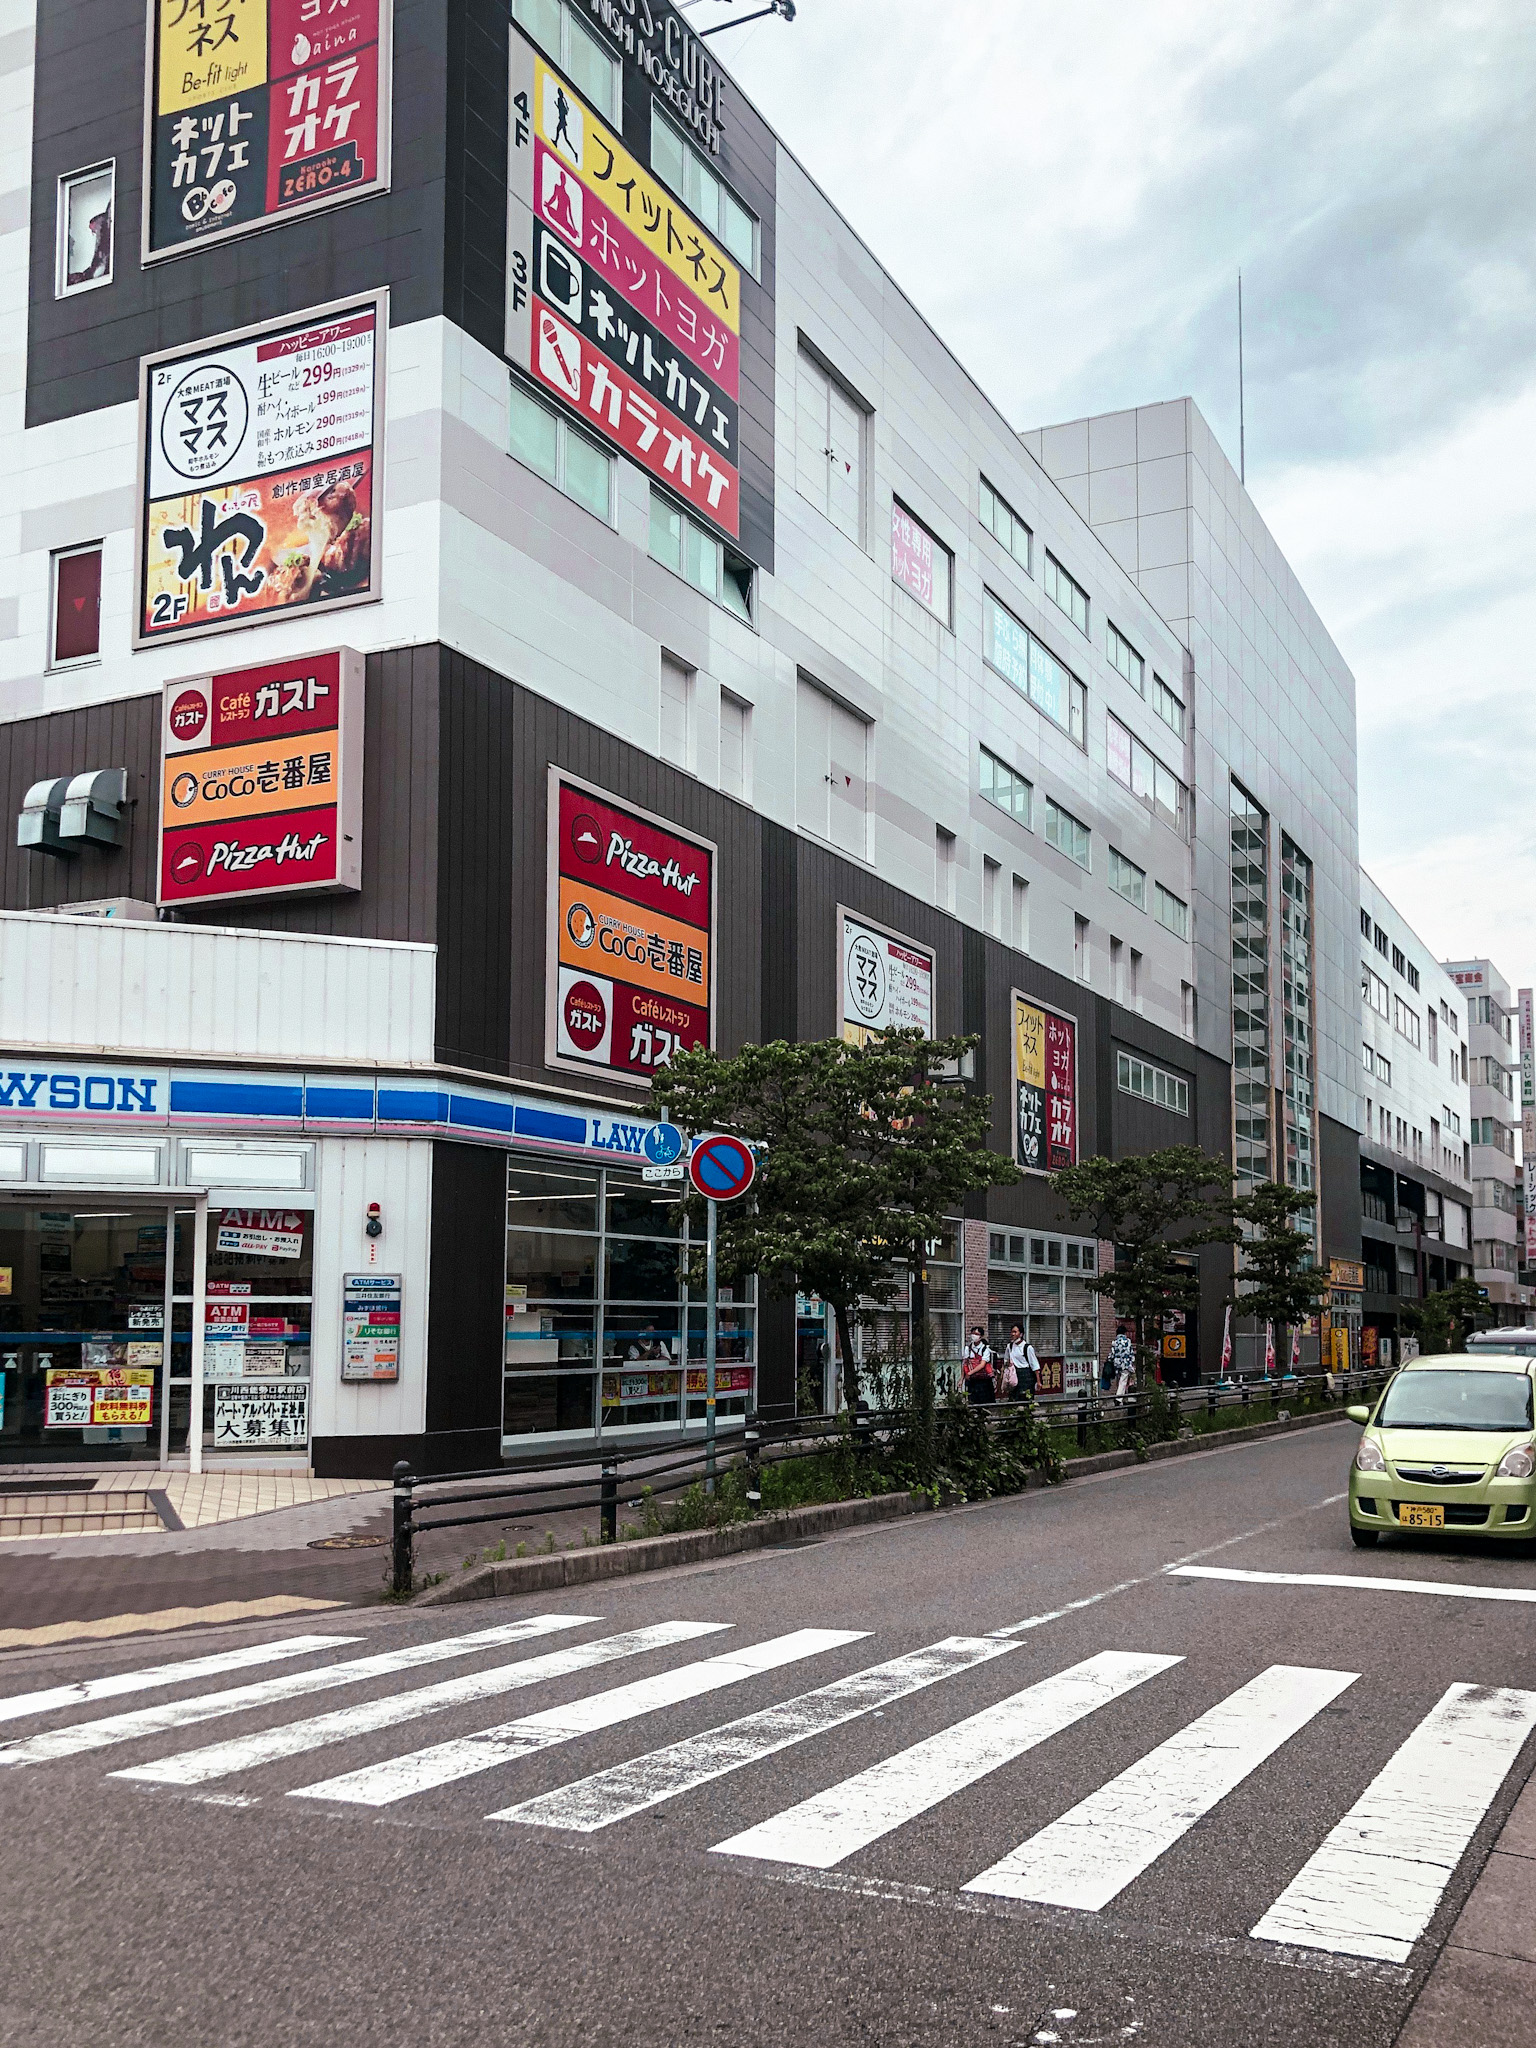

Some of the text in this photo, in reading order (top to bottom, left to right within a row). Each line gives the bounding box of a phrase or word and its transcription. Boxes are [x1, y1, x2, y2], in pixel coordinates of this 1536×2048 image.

[186, 14, 239, 57] ネス
[313, 28, 357, 55] aina
[182, 61, 248, 94] Be-fit light
[287, 56, 359, 118] カラ
[637, 39, 720, 155] NOSEGUCHI
[171, 102, 253, 152] ネット
[284, 101, 360, 159] オケ
[513, 91, 530, 148] 4F
[170, 140, 249, 188] カフェ
[284, 160, 352, 197] ZERO-4
[592, 133, 729, 310] フィットネス
[512, 250, 528, 312] 3F
[590, 216, 729, 371] ホットヨガ
[279, 325, 352, 353] ハッピーアワー
[158, 372, 172, 386] 2F
[257, 366, 301, 400] 生ビール
[588, 289, 730, 450] ネットカフェ
[180, 391, 228, 426] マス
[276, 401, 316, 421] ハイボール
[180, 420, 228, 455] マス
[273, 422, 315, 442] ホルモン
[586, 361, 730, 510] カラオケ
[271, 461, 364, 500] 創作個室居酒屋
[893, 505, 931, 568] 女性専用
[153, 594, 187, 623] 2F
[221, 692, 251, 711] Café
[254, 677, 329, 720] ガスト
[174, 711, 204, 728] ガスト
[221, 708, 251, 723] レストラン
[202, 764, 254, 780] CURRY HOUSE
[206, 833, 329, 877] Pizza Hut
[606, 832, 700, 896] Pizza Hut
[598, 914, 646, 939] CURRY HOUSE
[856, 954, 877, 980] マス
[856, 975, 878, 1002] マス
[569, 1009, 602, 1033] ガスト
[1017, 1007, 1044, 1036] フィット
[1048, 1021, 1071, 1049] ホット
[1023, 1032, 1038, 1056] ネス
[1020, 1085, 1042, 1112] ネット
[1050, 1095, 1071, 1121] カラ
[1020, 1108, 1042, 1135] カフェ
[1050, 1120, 1072, 1145] オケ
[592, 1119, 649, 1154] LAW
[645, 1166, 681, 1179] ここから
[222, 1208, 284, 1230] ATM
[210, 1306, 242, 1317] ATM
[52, 1392, 87, 1402] おにぎり
[55, 1411, 86, 1421] 買うと!
[102, 1411, 142, 1420] もらえる!
[217, 1419, 306, 1439] 大募集!!
[1409, 1513, 1442, 1526] 85-15
